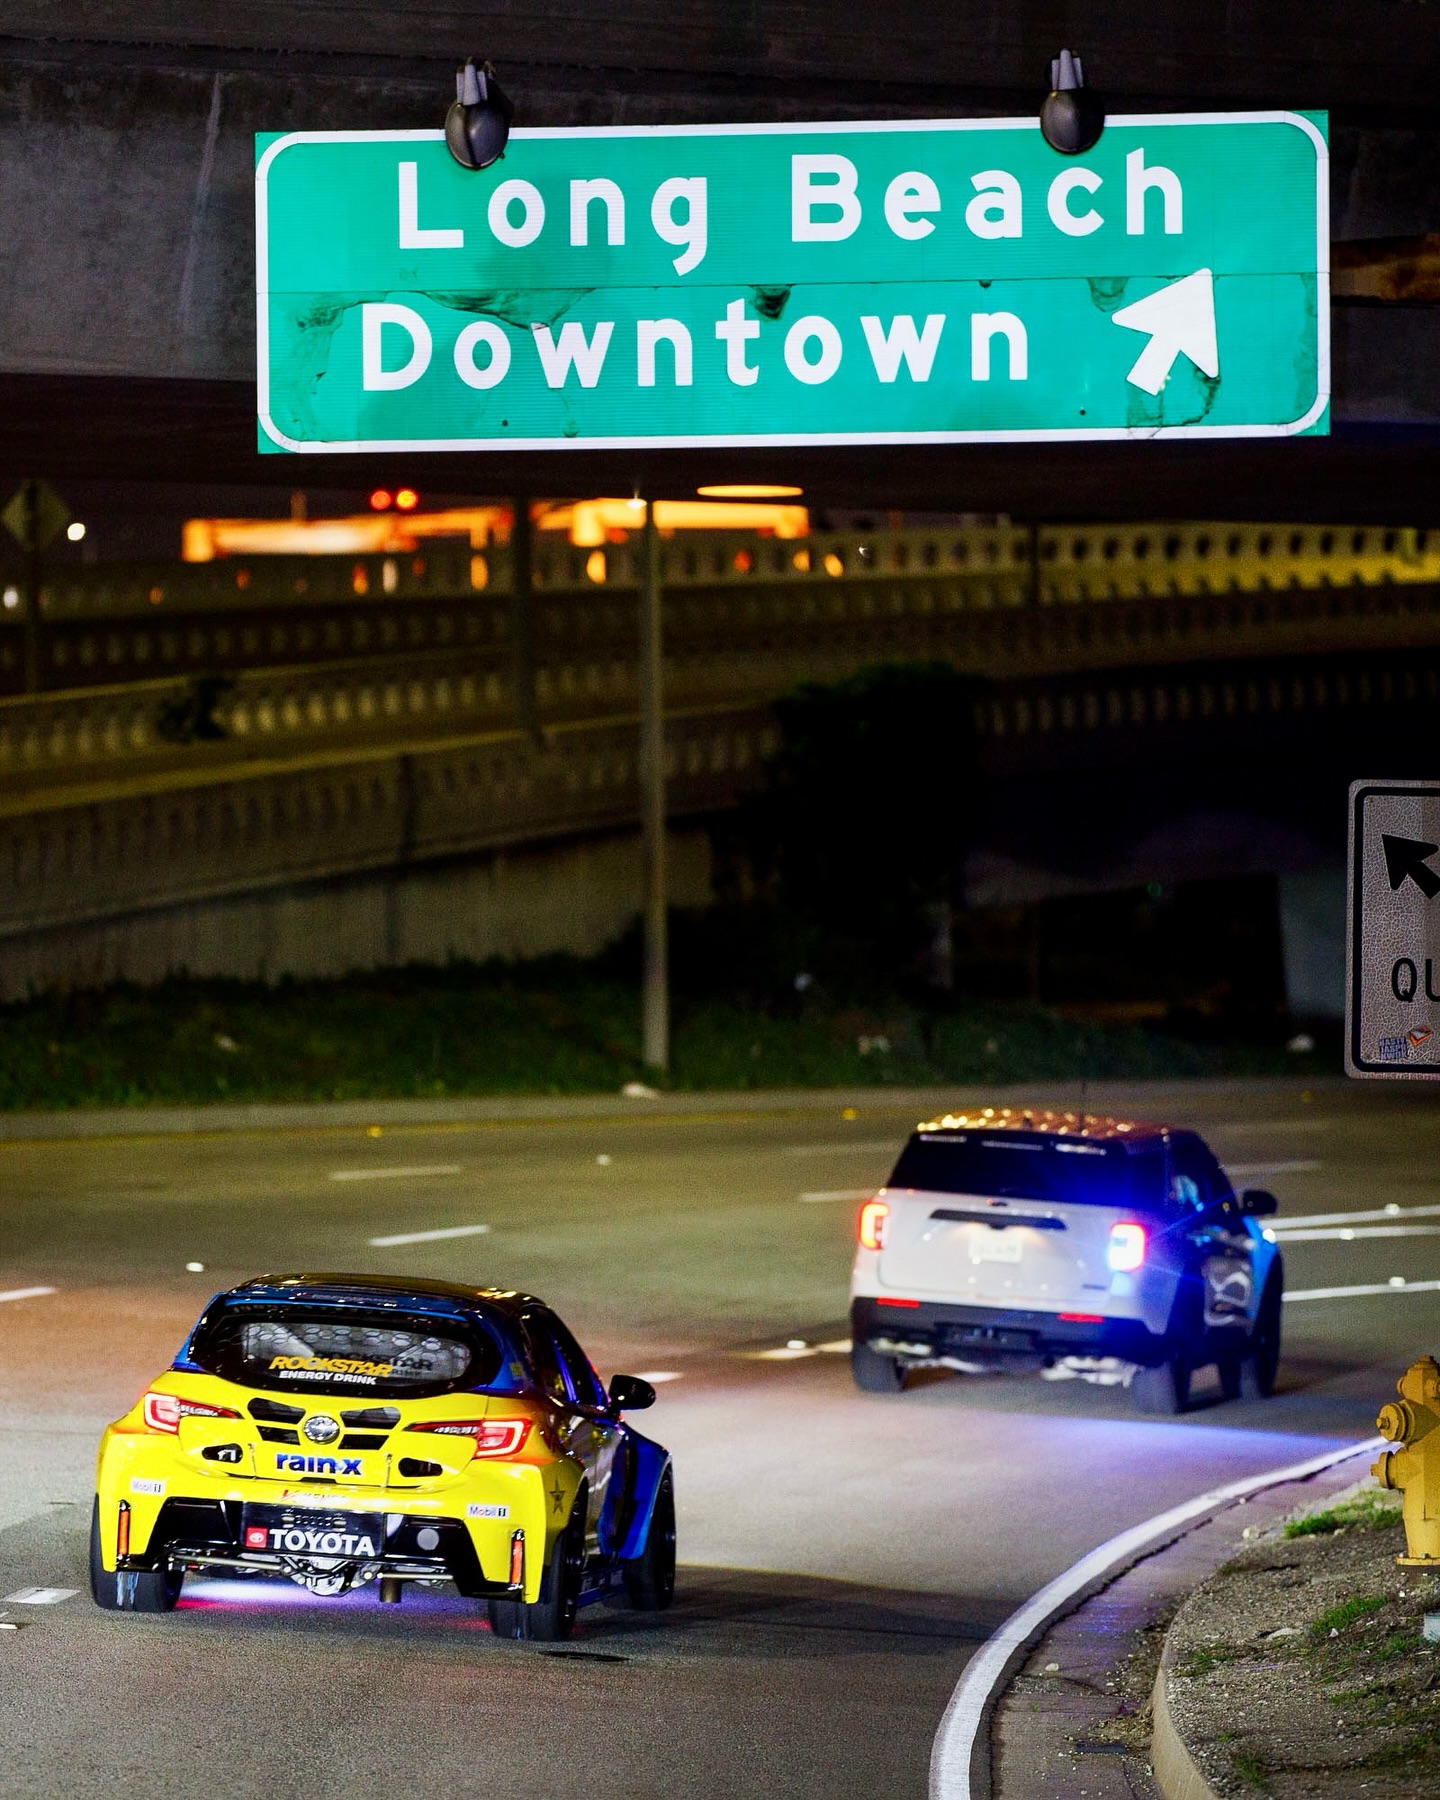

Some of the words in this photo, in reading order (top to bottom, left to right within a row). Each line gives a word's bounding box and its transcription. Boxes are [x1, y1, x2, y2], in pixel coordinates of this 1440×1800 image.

[398, 161, 708, 276] Long
[791, 147, 1183, 242] Beach
[362, 298, 1028, 391] Downtown
[269, 1355, 394, 1377] ROCKSTAR
[279, 1370, 333, 1381] ENERGY
[333, 1373, 377, 1386] DRINK
[468, 1505, 497, 1517] Mobil
[268, 1528, 376, 1557] TOYOTA
